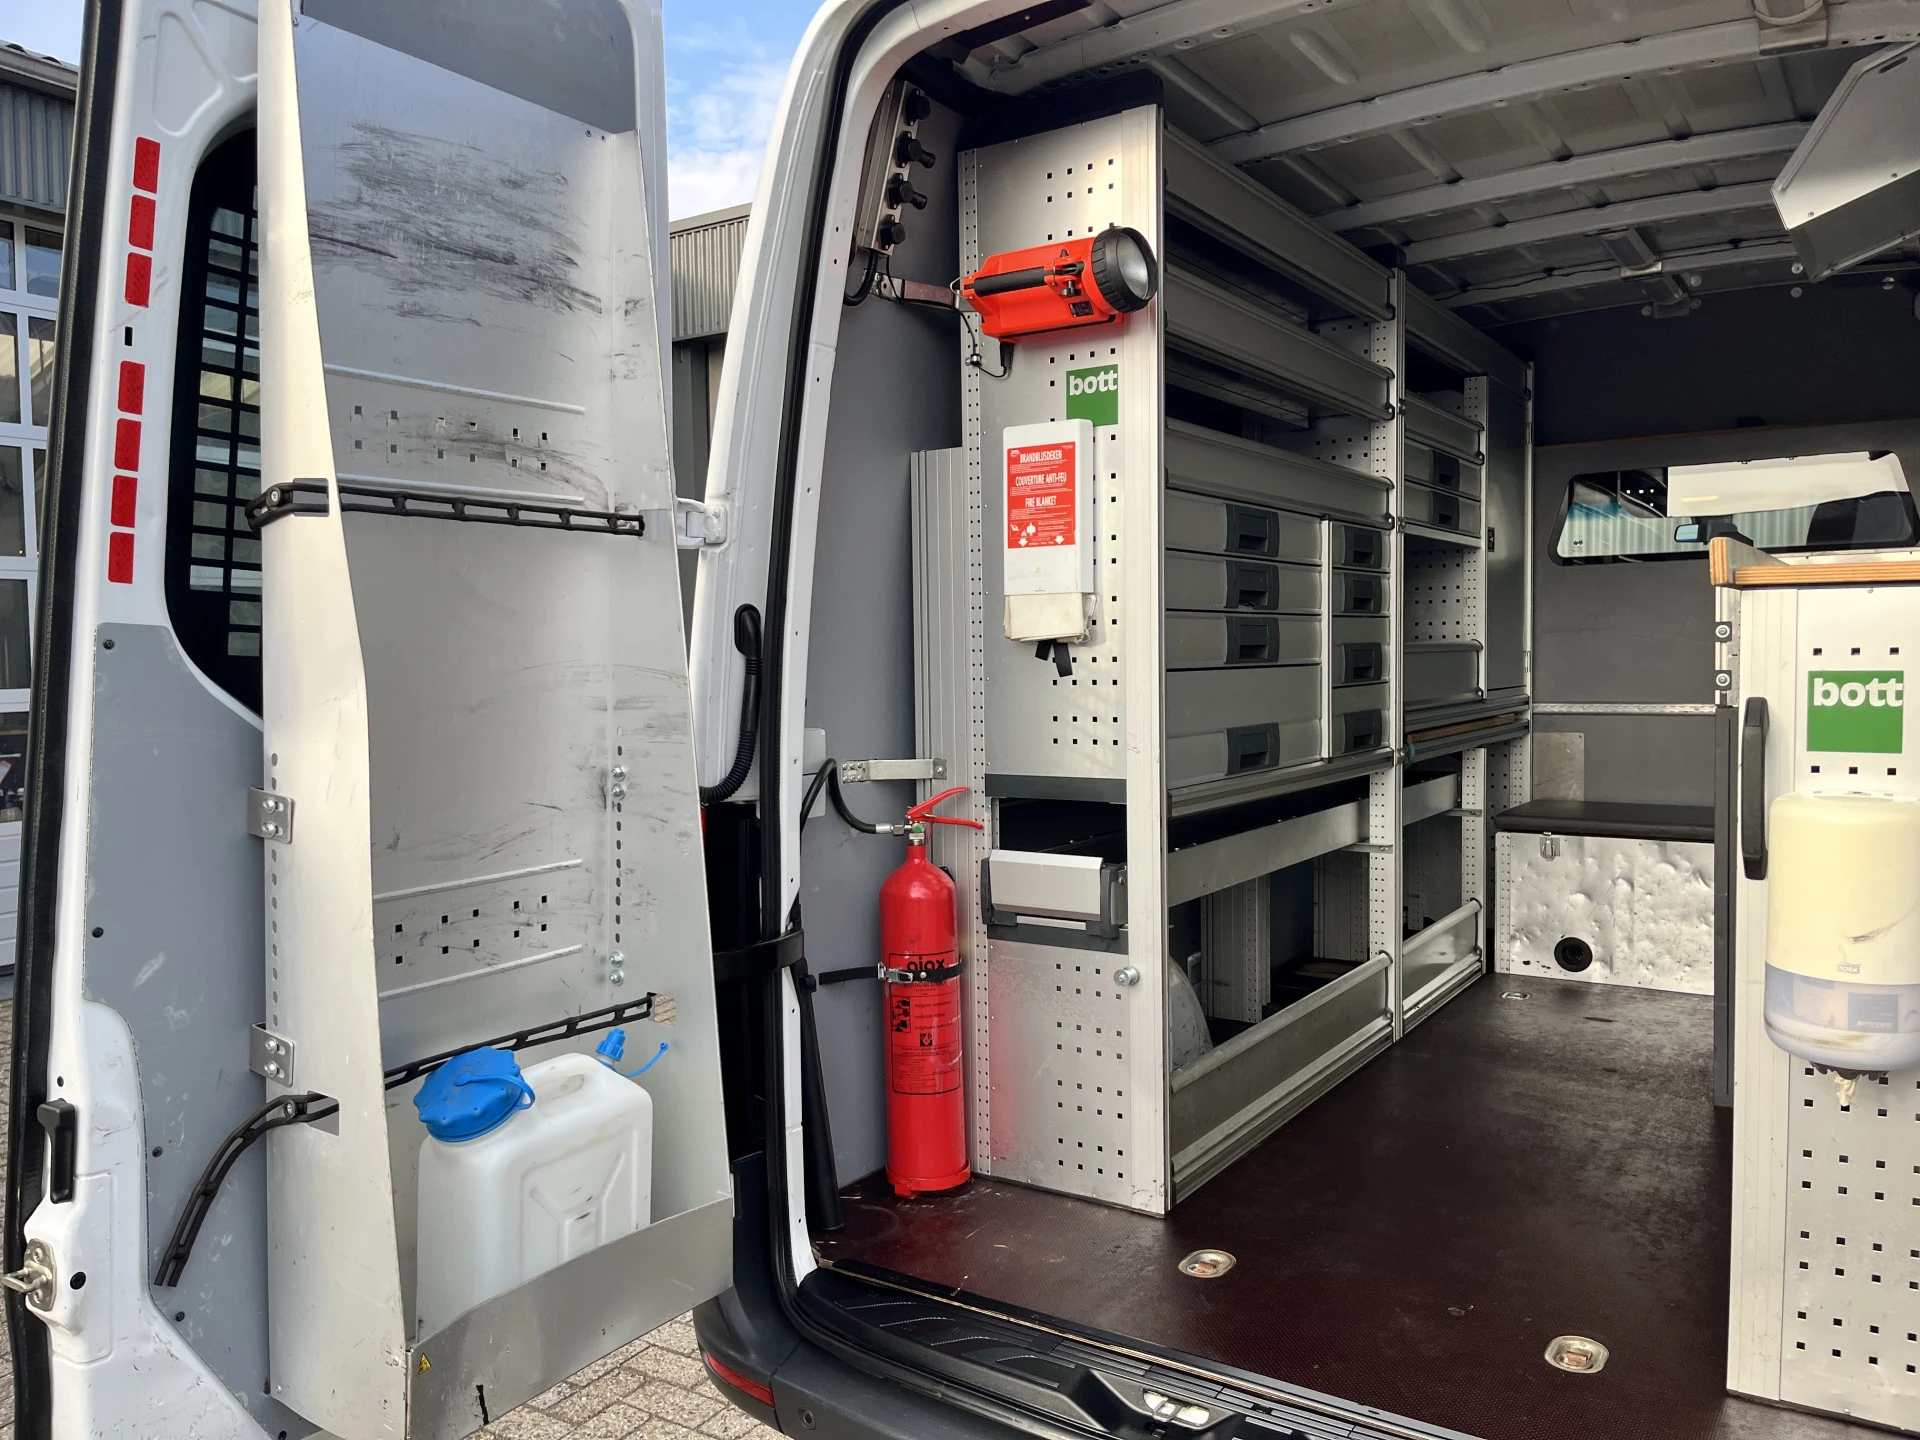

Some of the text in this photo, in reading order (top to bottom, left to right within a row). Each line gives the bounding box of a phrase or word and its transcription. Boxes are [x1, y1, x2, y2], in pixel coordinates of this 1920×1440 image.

[1069, 370, 1118, 396] bott
[1020, 449, 1063, 464] BRANDBLUSDEKEN
[1015, 472, 1067, 487] COUVERTURE ANTI-FEU
[1025, 495, 1057, 508] FIRE BLANKET
[1813, 677, 1904, 707] bott
